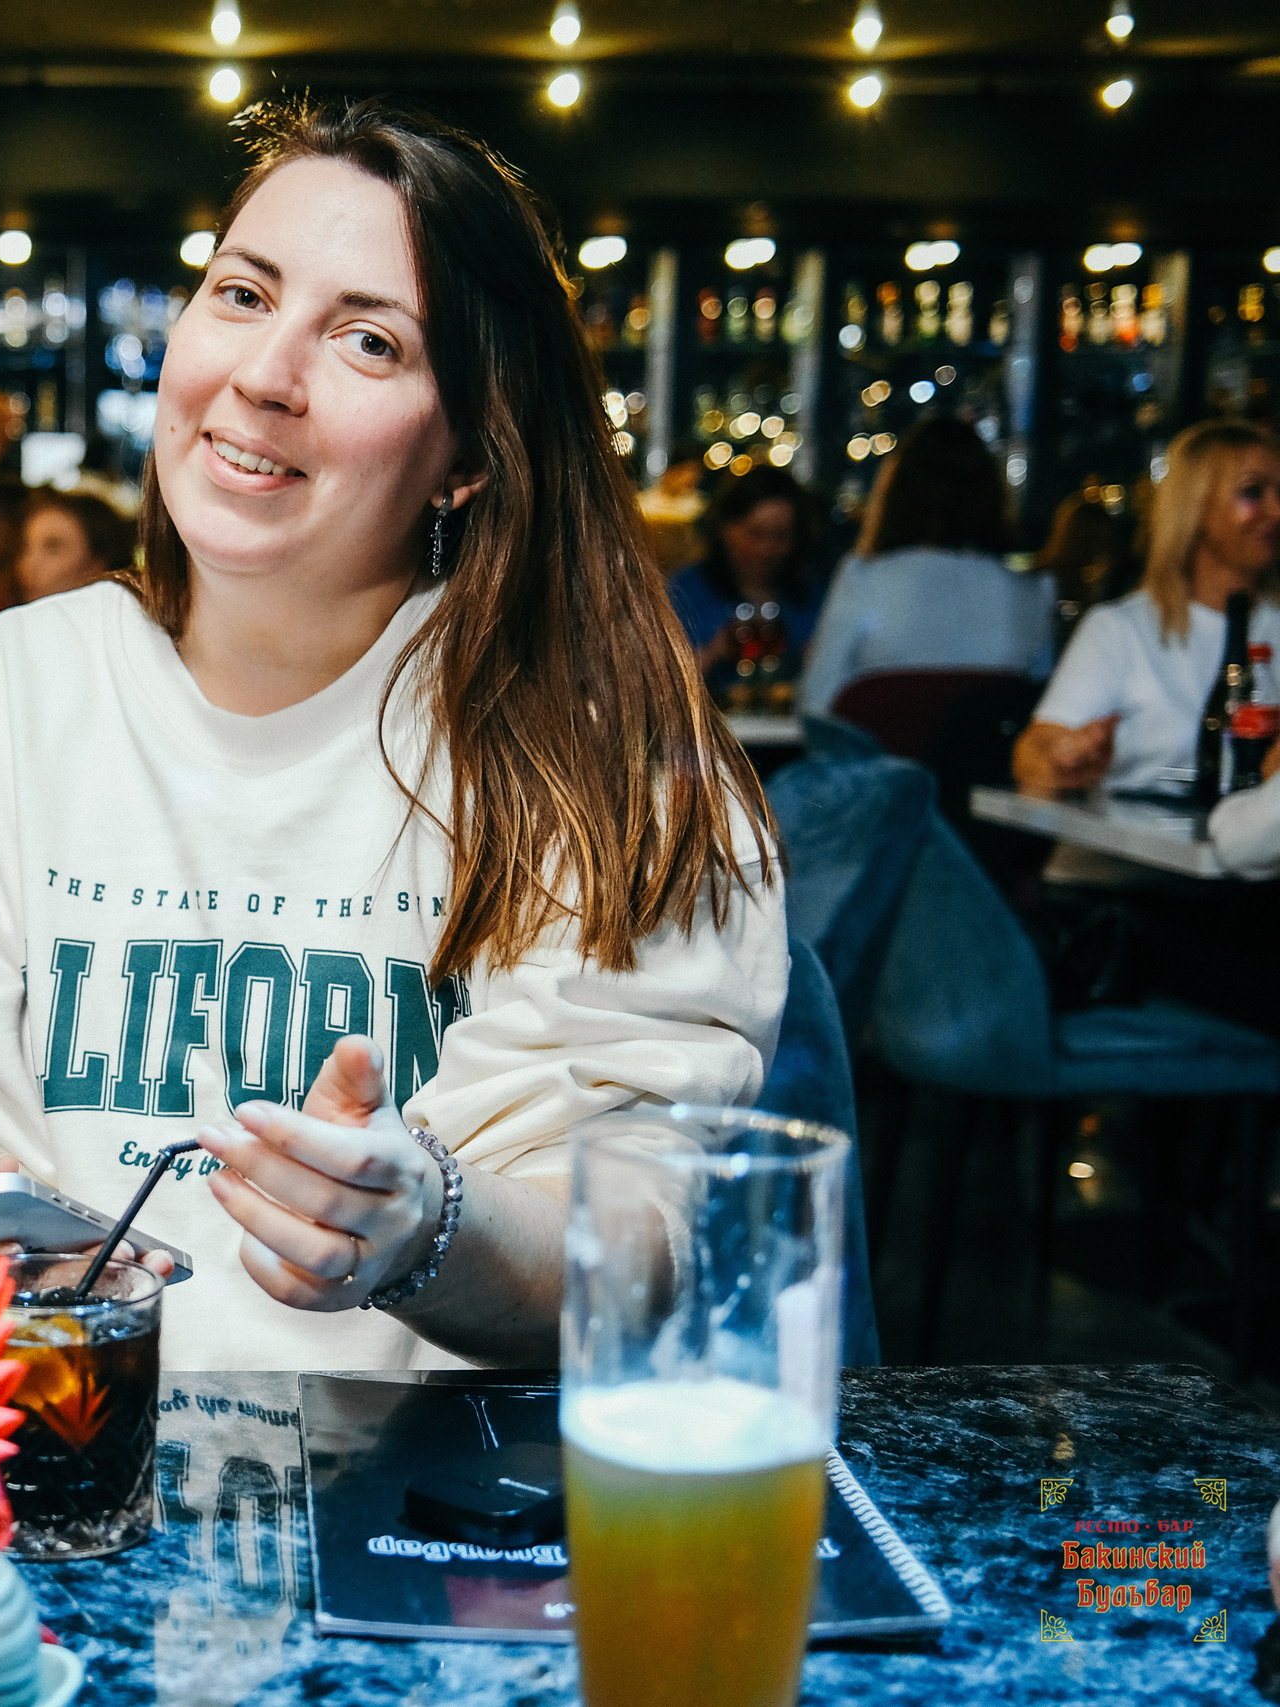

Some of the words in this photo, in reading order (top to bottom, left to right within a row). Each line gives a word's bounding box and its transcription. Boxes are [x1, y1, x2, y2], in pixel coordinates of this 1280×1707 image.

[48, 868, 106, 902] THE
[131, 888, 218, 910] STAE
[247, 893, 286, 915] OF
[316, 895, 373, 918] THE
[397, 892, 446, 917] SN
